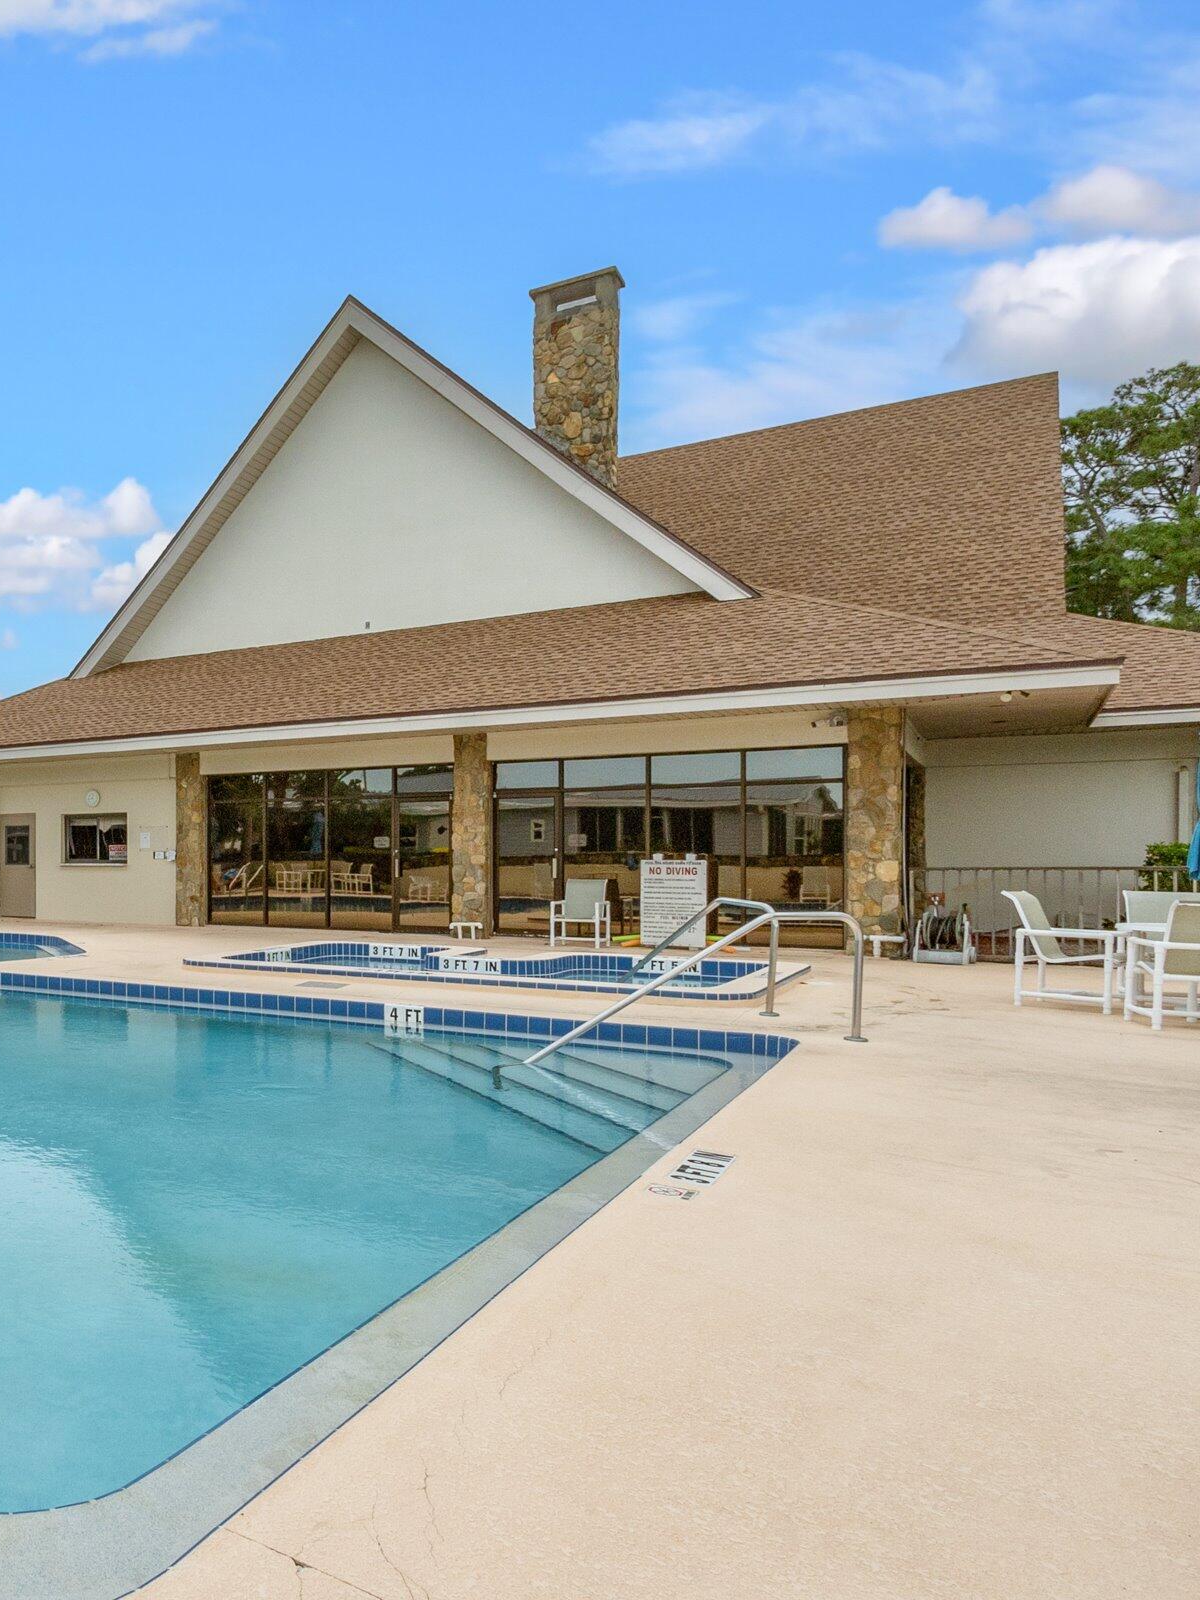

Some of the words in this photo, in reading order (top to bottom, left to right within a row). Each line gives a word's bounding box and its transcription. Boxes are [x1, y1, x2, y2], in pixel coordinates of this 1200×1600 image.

[649, 867, 661, 875] NO
[666, 867, 698, 876] DIVING
[373, 946, 378, 955] 3
[398, 947, 403, 956] 7
[443, 959, 449, 969] 3
[473, 961, 479, 970] 7
[390, 1007, 398, 1021] 4
[676, 1164, 720, 1178] FT
